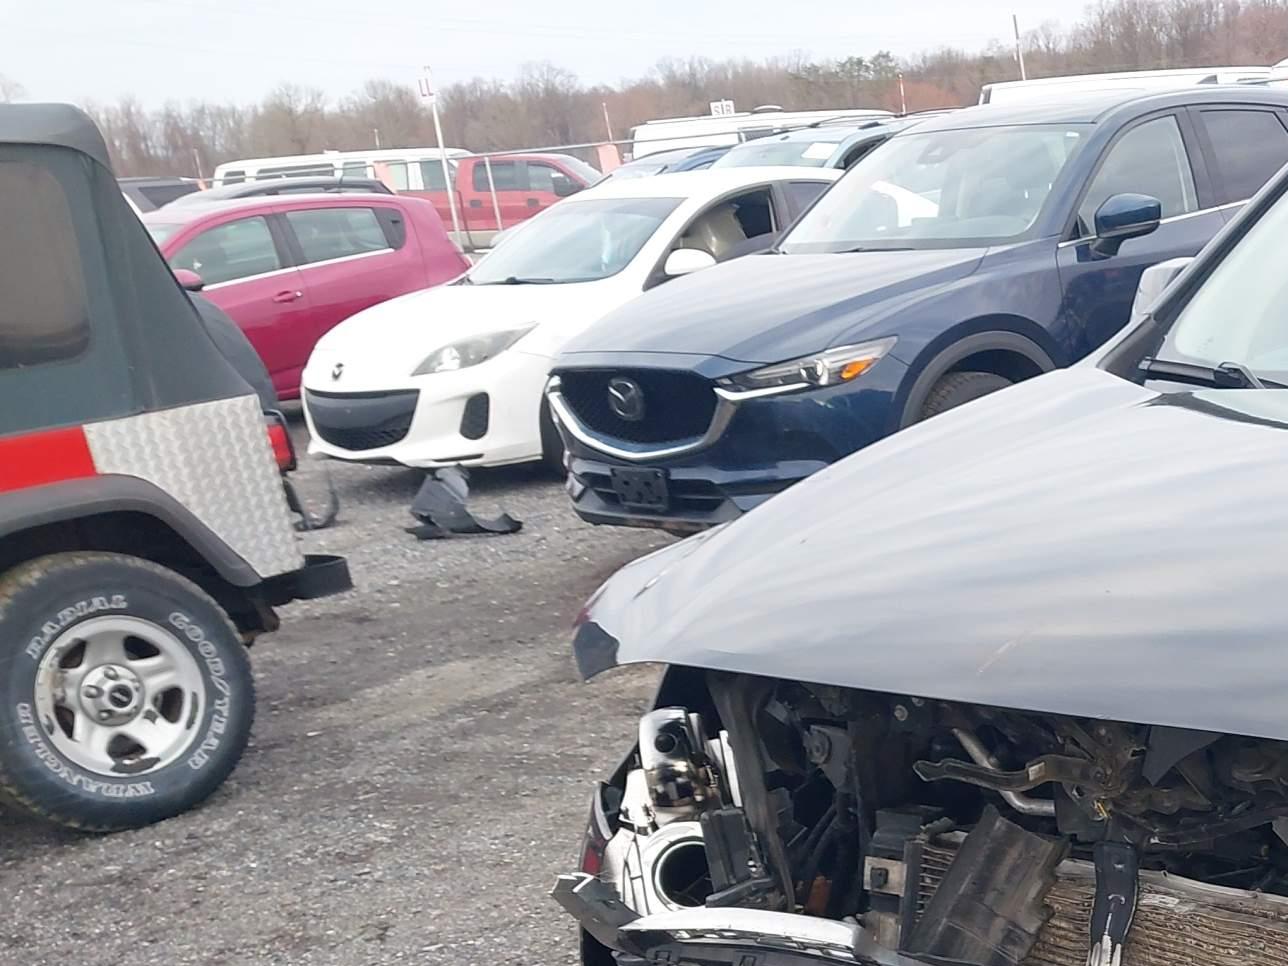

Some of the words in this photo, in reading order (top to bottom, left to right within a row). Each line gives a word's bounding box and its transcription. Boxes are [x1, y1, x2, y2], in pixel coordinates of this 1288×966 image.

[26, 595, 129, 659] RADIAL
[168, 611, 231, 770] GOODYEAR
[16, 702, 156, 797] WRANGLER
